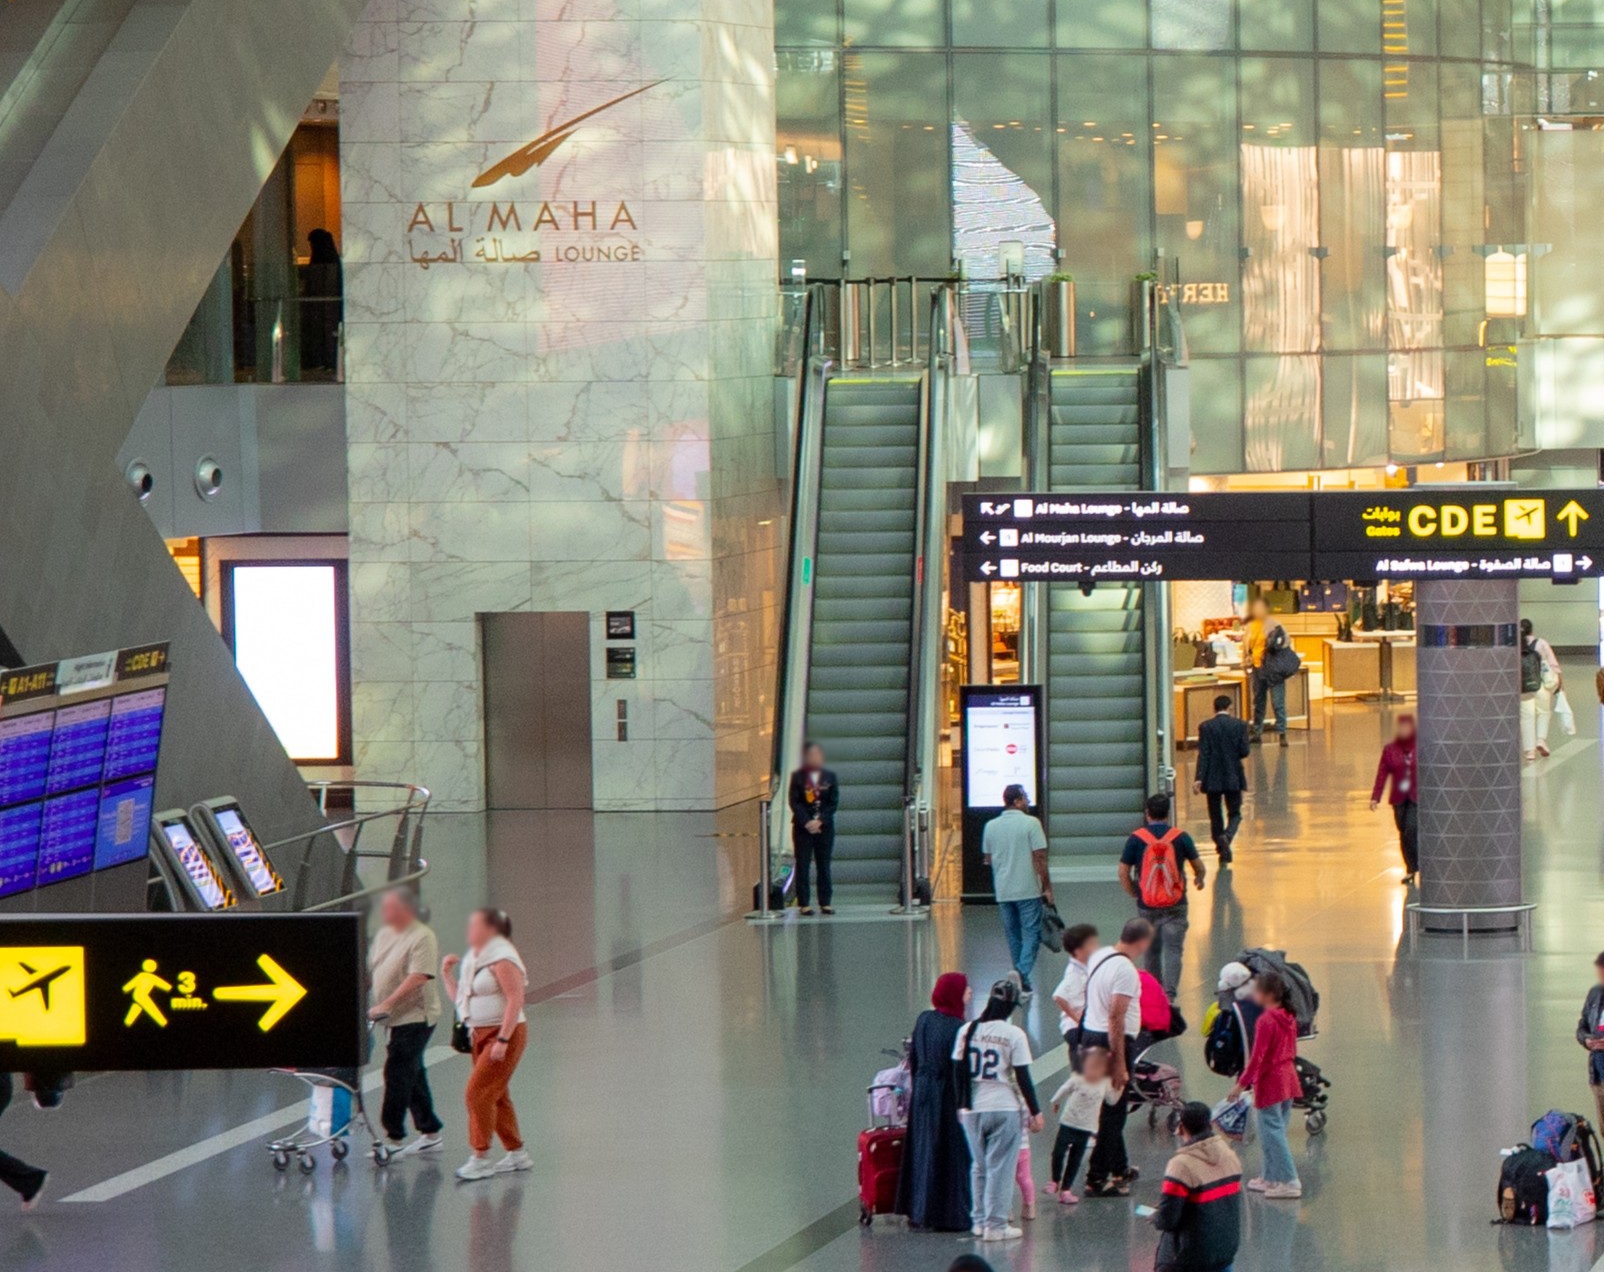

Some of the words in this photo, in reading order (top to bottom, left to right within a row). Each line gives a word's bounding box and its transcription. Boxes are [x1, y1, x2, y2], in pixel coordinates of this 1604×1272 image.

[407, 201, 464, 233] AL
[486, 200, 638, 233] MAHA
[406, 237, 464, 270] المها
[474, 236, 542, 264] صالة
[555, 244, 641, 263] LOUNGE
[1407, 504, 1497, 537] CDE
[1365, 525, 1401, 537] Gates
[1020, 561, 1050, 574] Food
[1049, 562, 1083, 574] Court
[1090, 560, 1139, 577] المطاعم
[1140, 560, 1163, 576] ركن
[177, 971, 196, 994] 3
[171, 994, 208, 1010] min.
